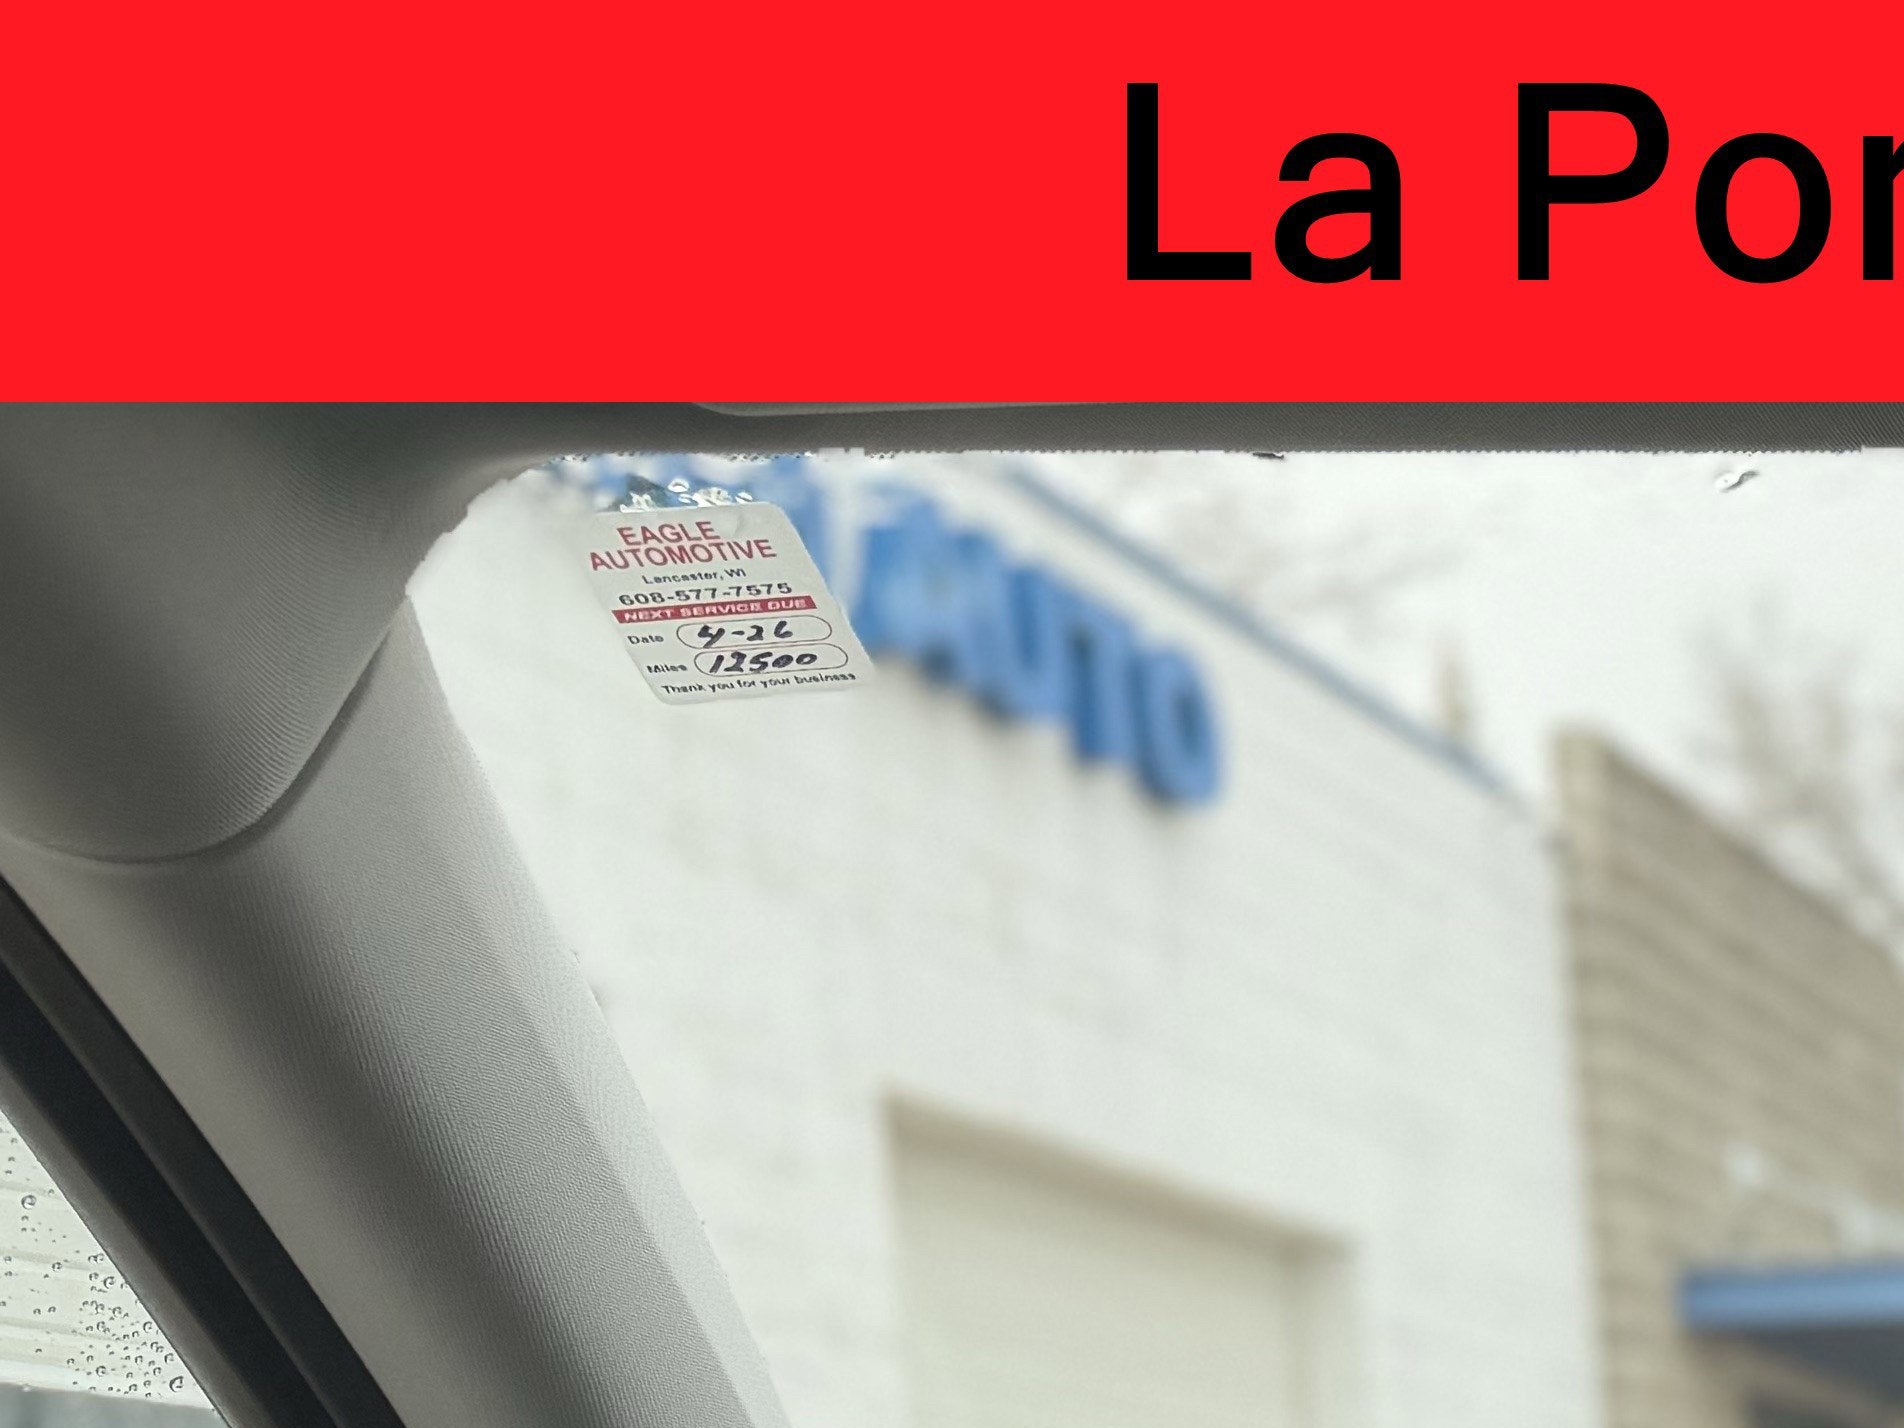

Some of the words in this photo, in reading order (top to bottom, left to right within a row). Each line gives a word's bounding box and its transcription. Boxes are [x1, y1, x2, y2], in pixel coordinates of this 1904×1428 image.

[617, 521, 720, 545] EAGLE
[590, 539, 777, 571] AUTOMOTIVE
[619, 582, 792, 606] 608-577-7575
[624, 609, 674, 622] NEXT
[680, 603, 761, 617] SERVICE
[767, 599, 807, 611] DUE
[627, 635, 665, 646] Date
[647, 664, 689, 674] Miles
[709, 651, 818, 674] 12500
[661, 682, 706, 694] Thank
[709, 681, 735, 693] you
[736, 678, 756, 688] for
[760, 677, 791, 689] your
[793, 672, 857, 685] business
